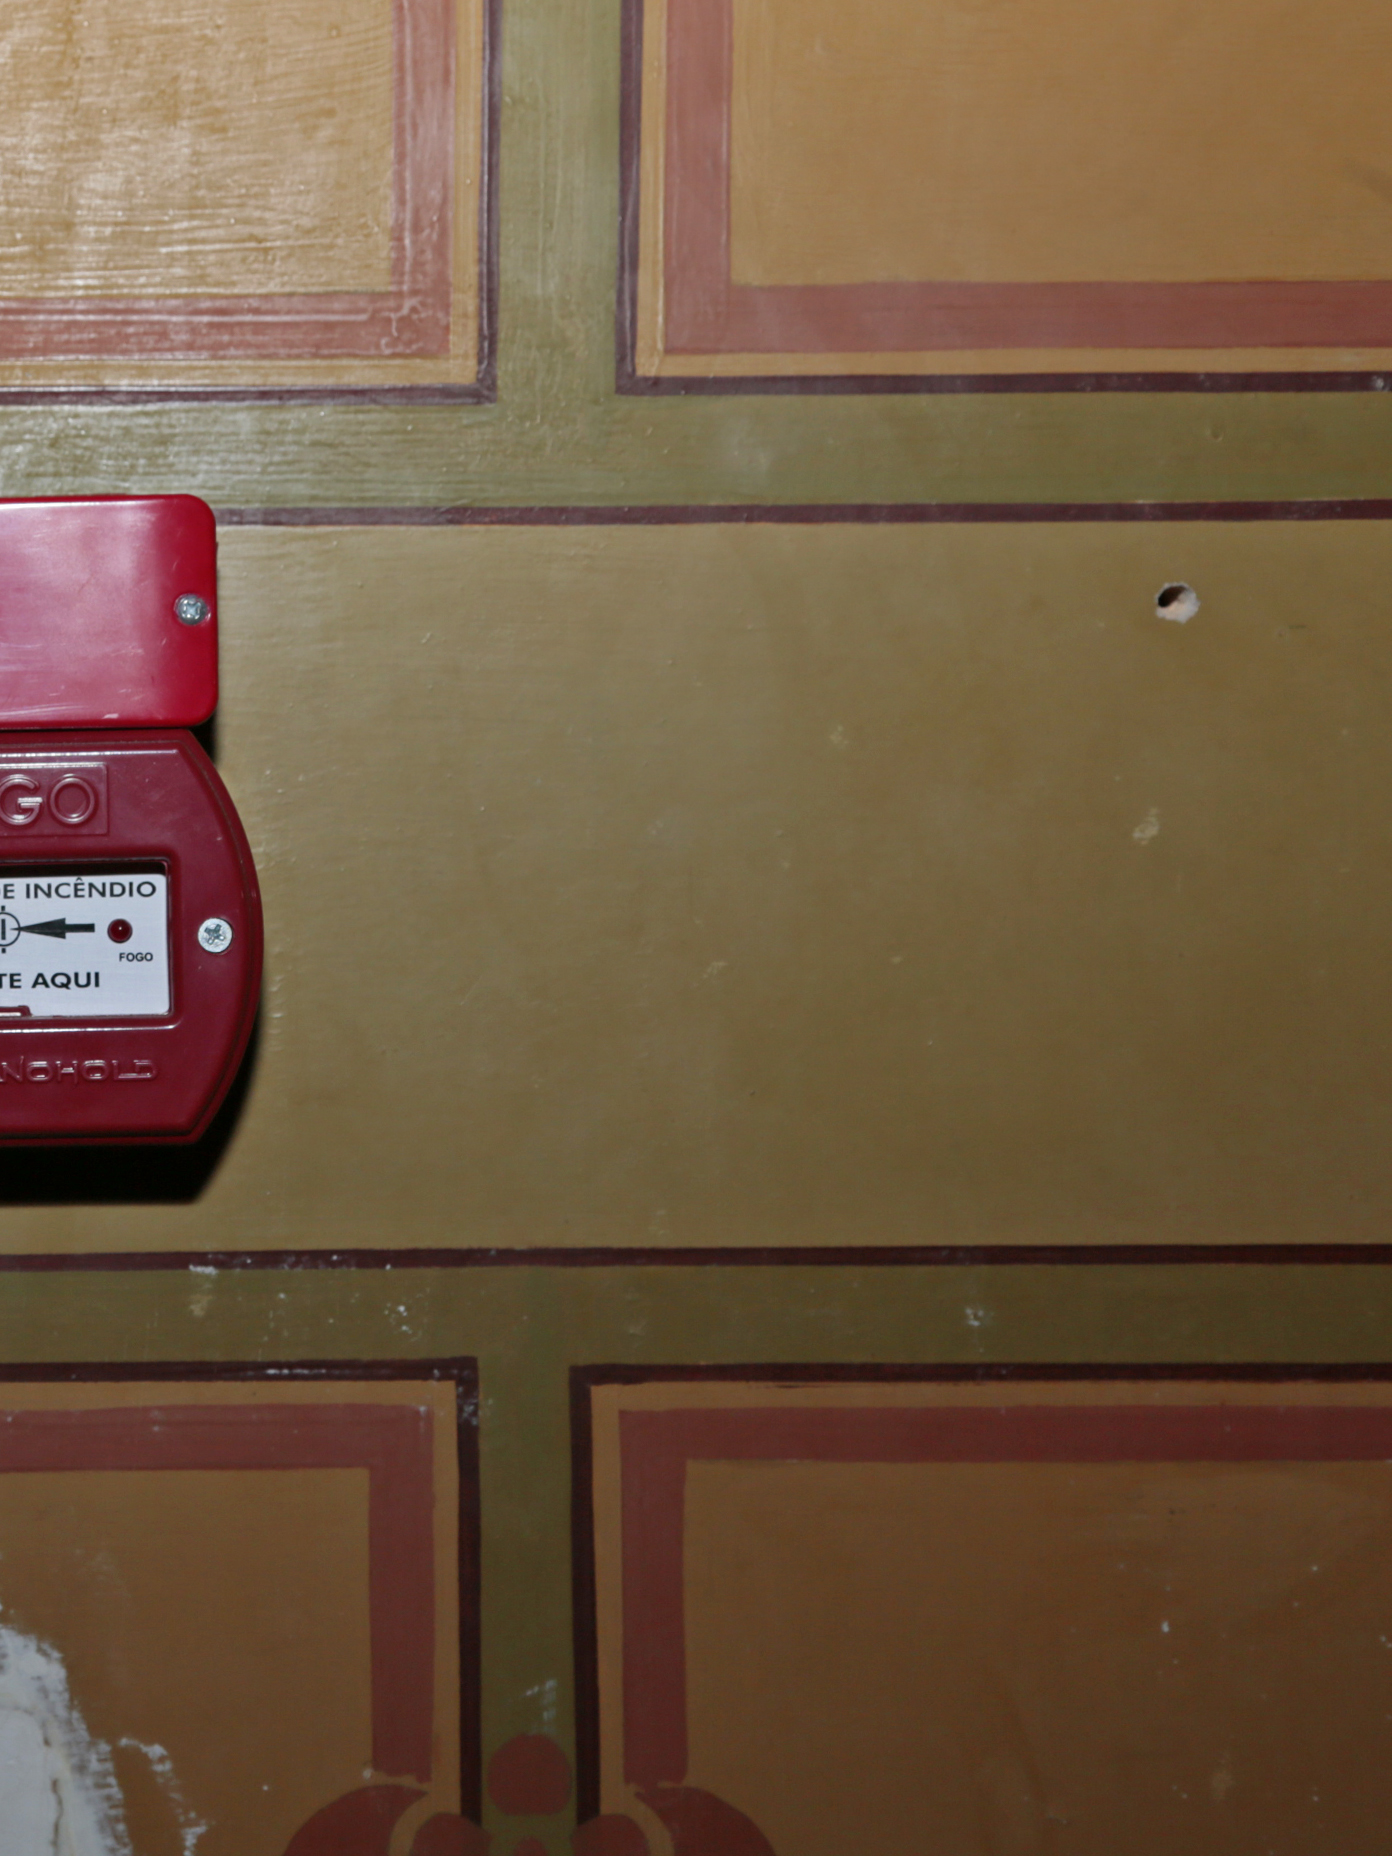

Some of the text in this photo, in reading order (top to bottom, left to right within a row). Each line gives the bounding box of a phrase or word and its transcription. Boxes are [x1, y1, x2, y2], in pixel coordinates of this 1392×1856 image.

[25, 877, 156, 898] INCÊNDIO
[119, 953, 153, 962] FOGO
[32, 972, 99, 989] AQUI
